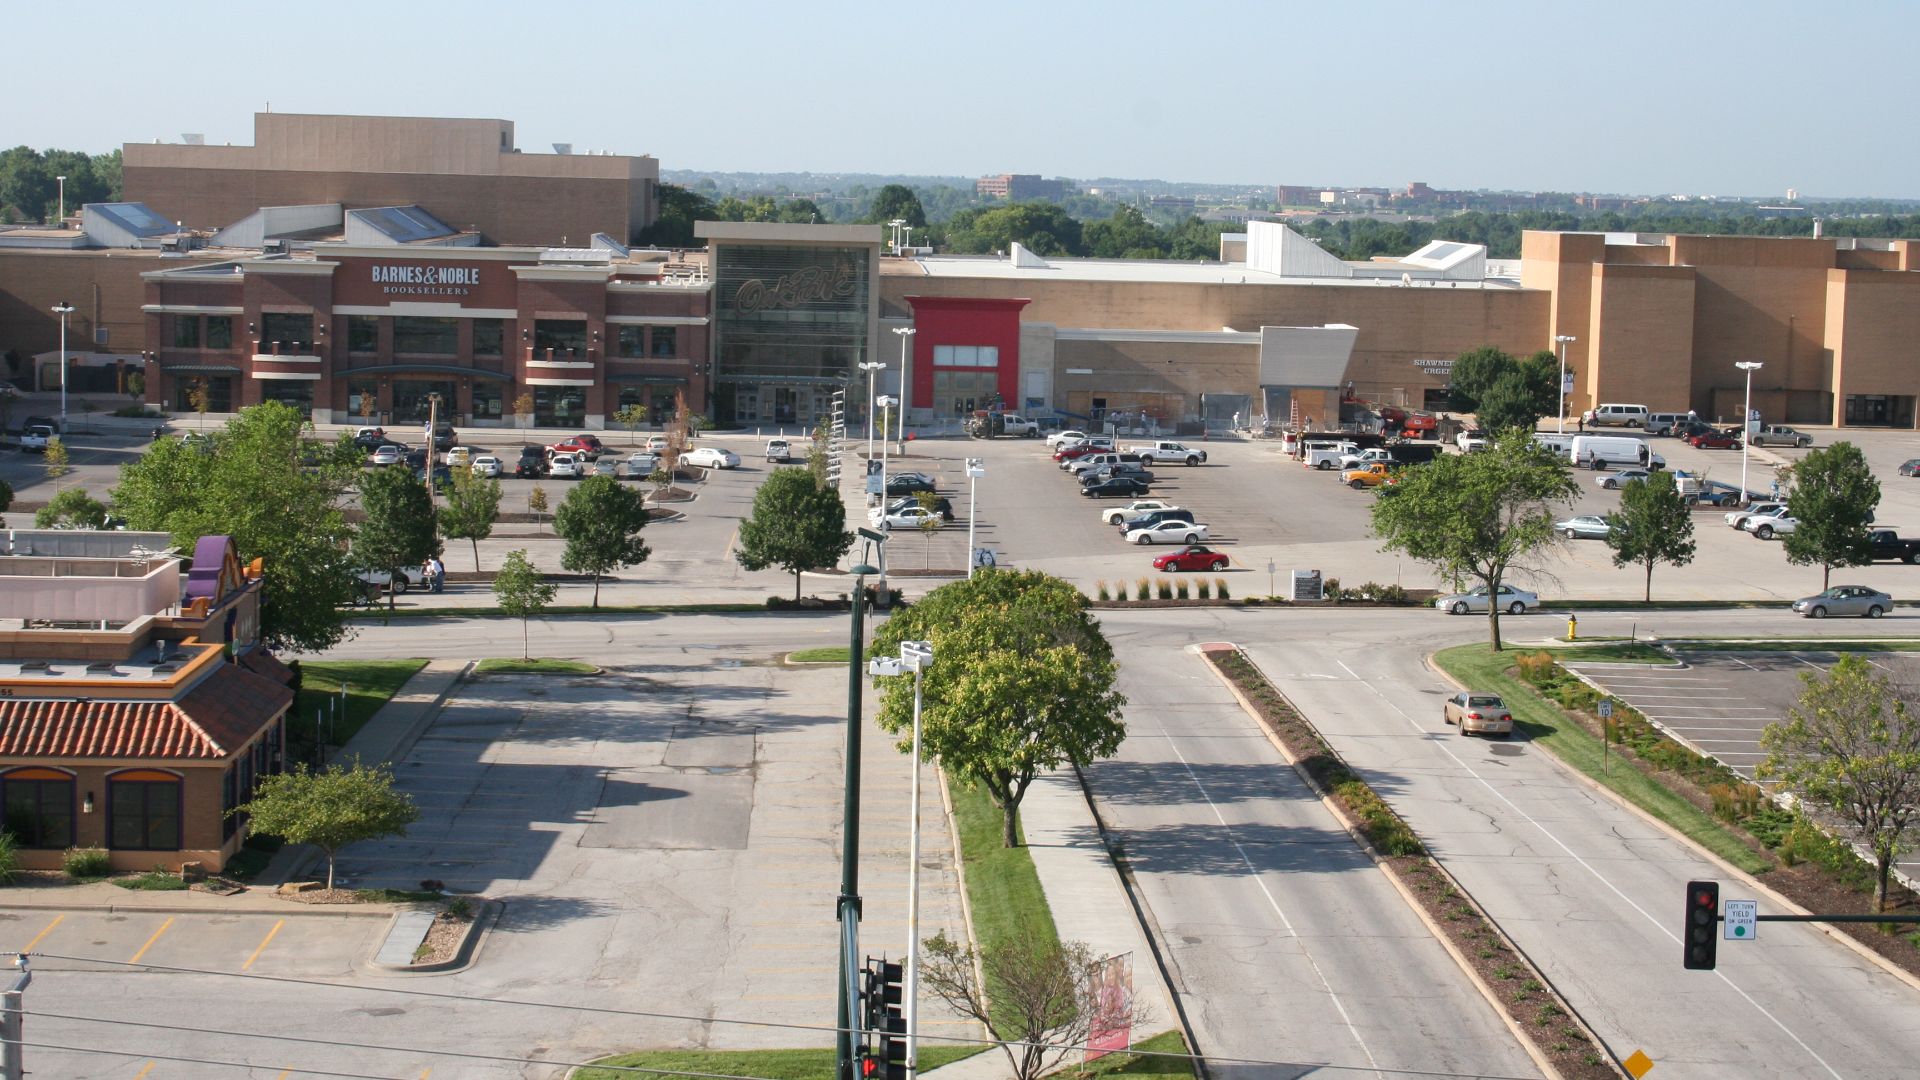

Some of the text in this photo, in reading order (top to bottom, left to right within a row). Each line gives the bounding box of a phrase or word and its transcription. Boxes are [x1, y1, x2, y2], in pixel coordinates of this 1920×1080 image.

[789, 259, 857, 304] Park
[383, 286, 469, 295] BOOKSELLERS
[1601, 708, 1610, 716] 10
